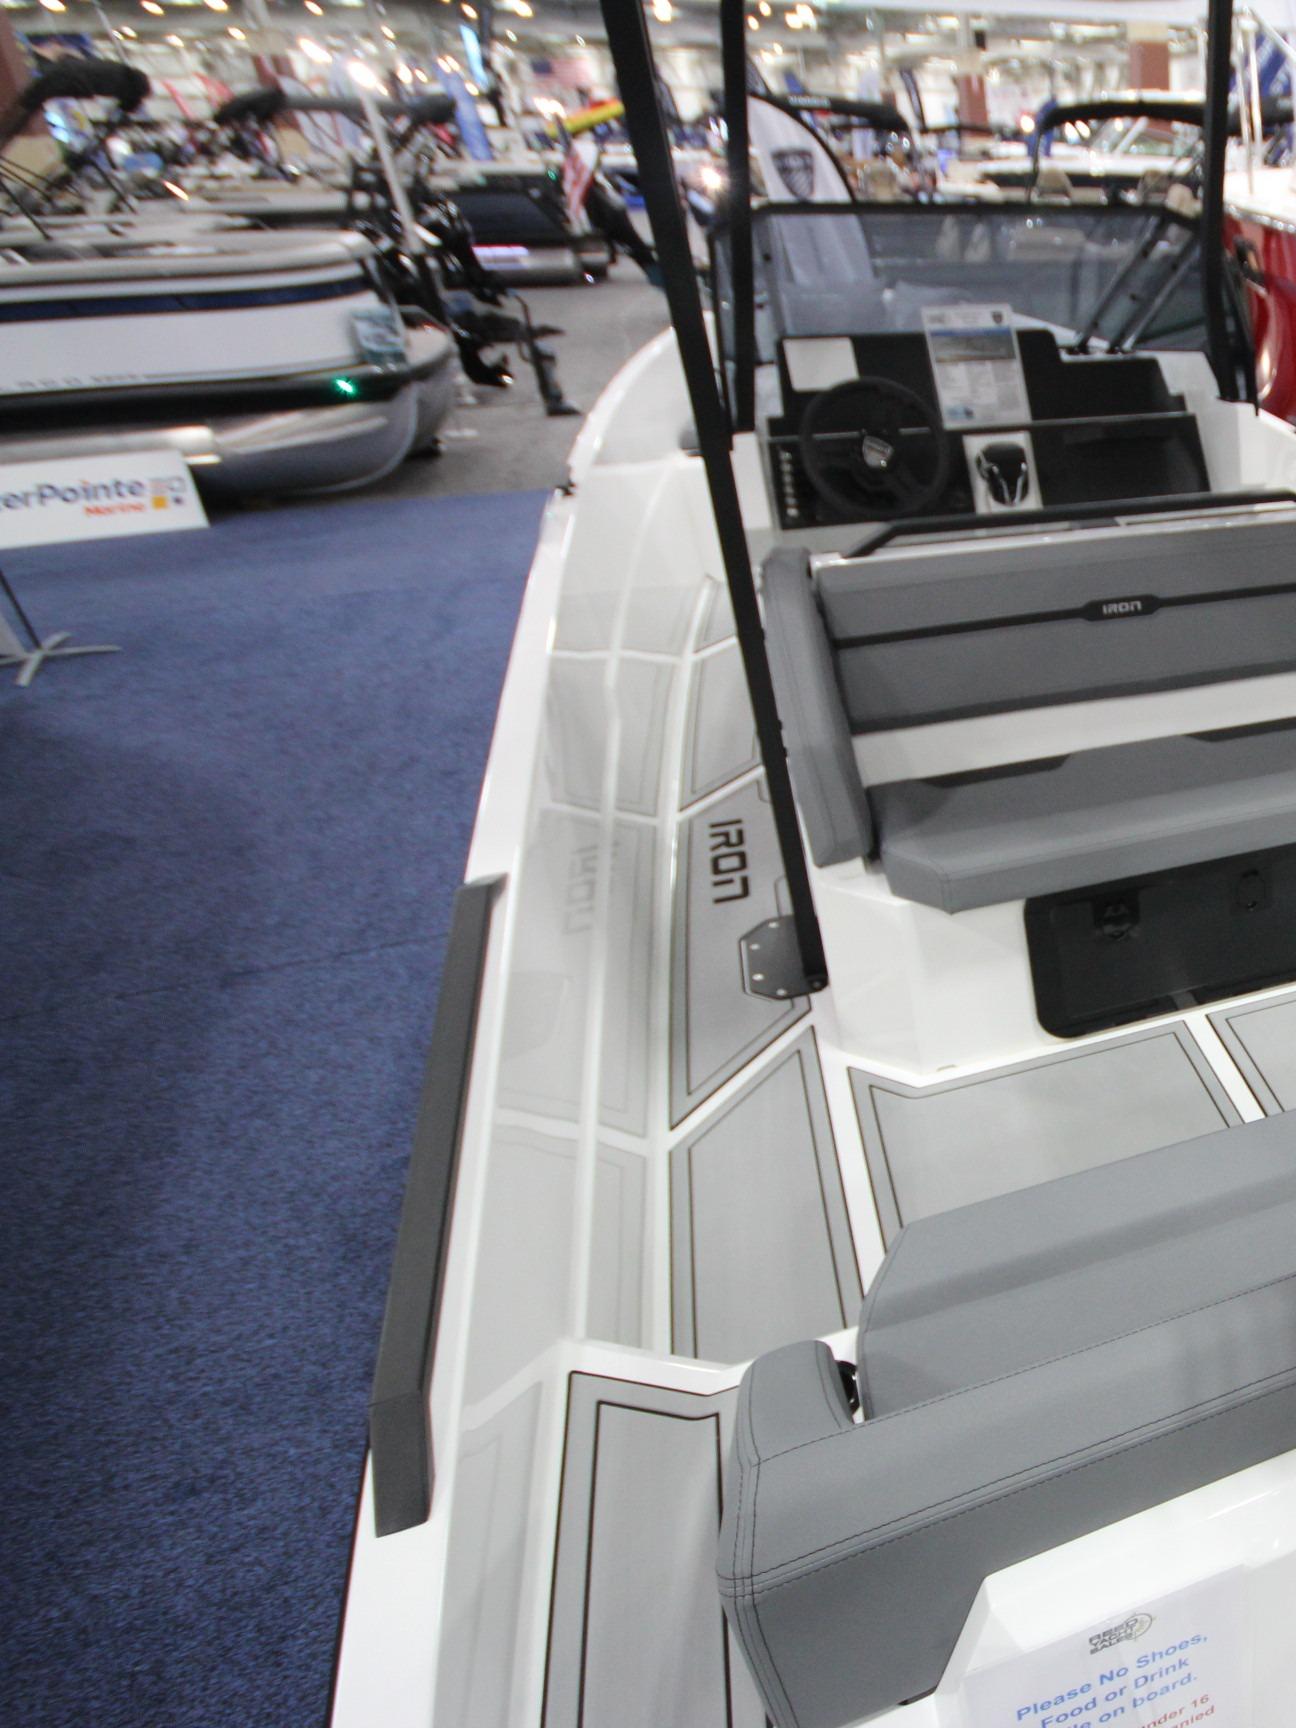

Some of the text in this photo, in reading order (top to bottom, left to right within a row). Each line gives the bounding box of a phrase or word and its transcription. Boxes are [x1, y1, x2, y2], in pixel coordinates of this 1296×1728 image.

[0, 479, 146, 511] erPointe
[1102, 600, 1142, 615] IRON
[709, 818, 750, 904] IRON
[1016, 1634, 1208, 1721] Please No Shoes,
[1041, 1657, 1190, 1728] Food or Drink
[1099, 1672, 1198, 1723] on board.
[1191, 1694, 1210, 1709] 16
